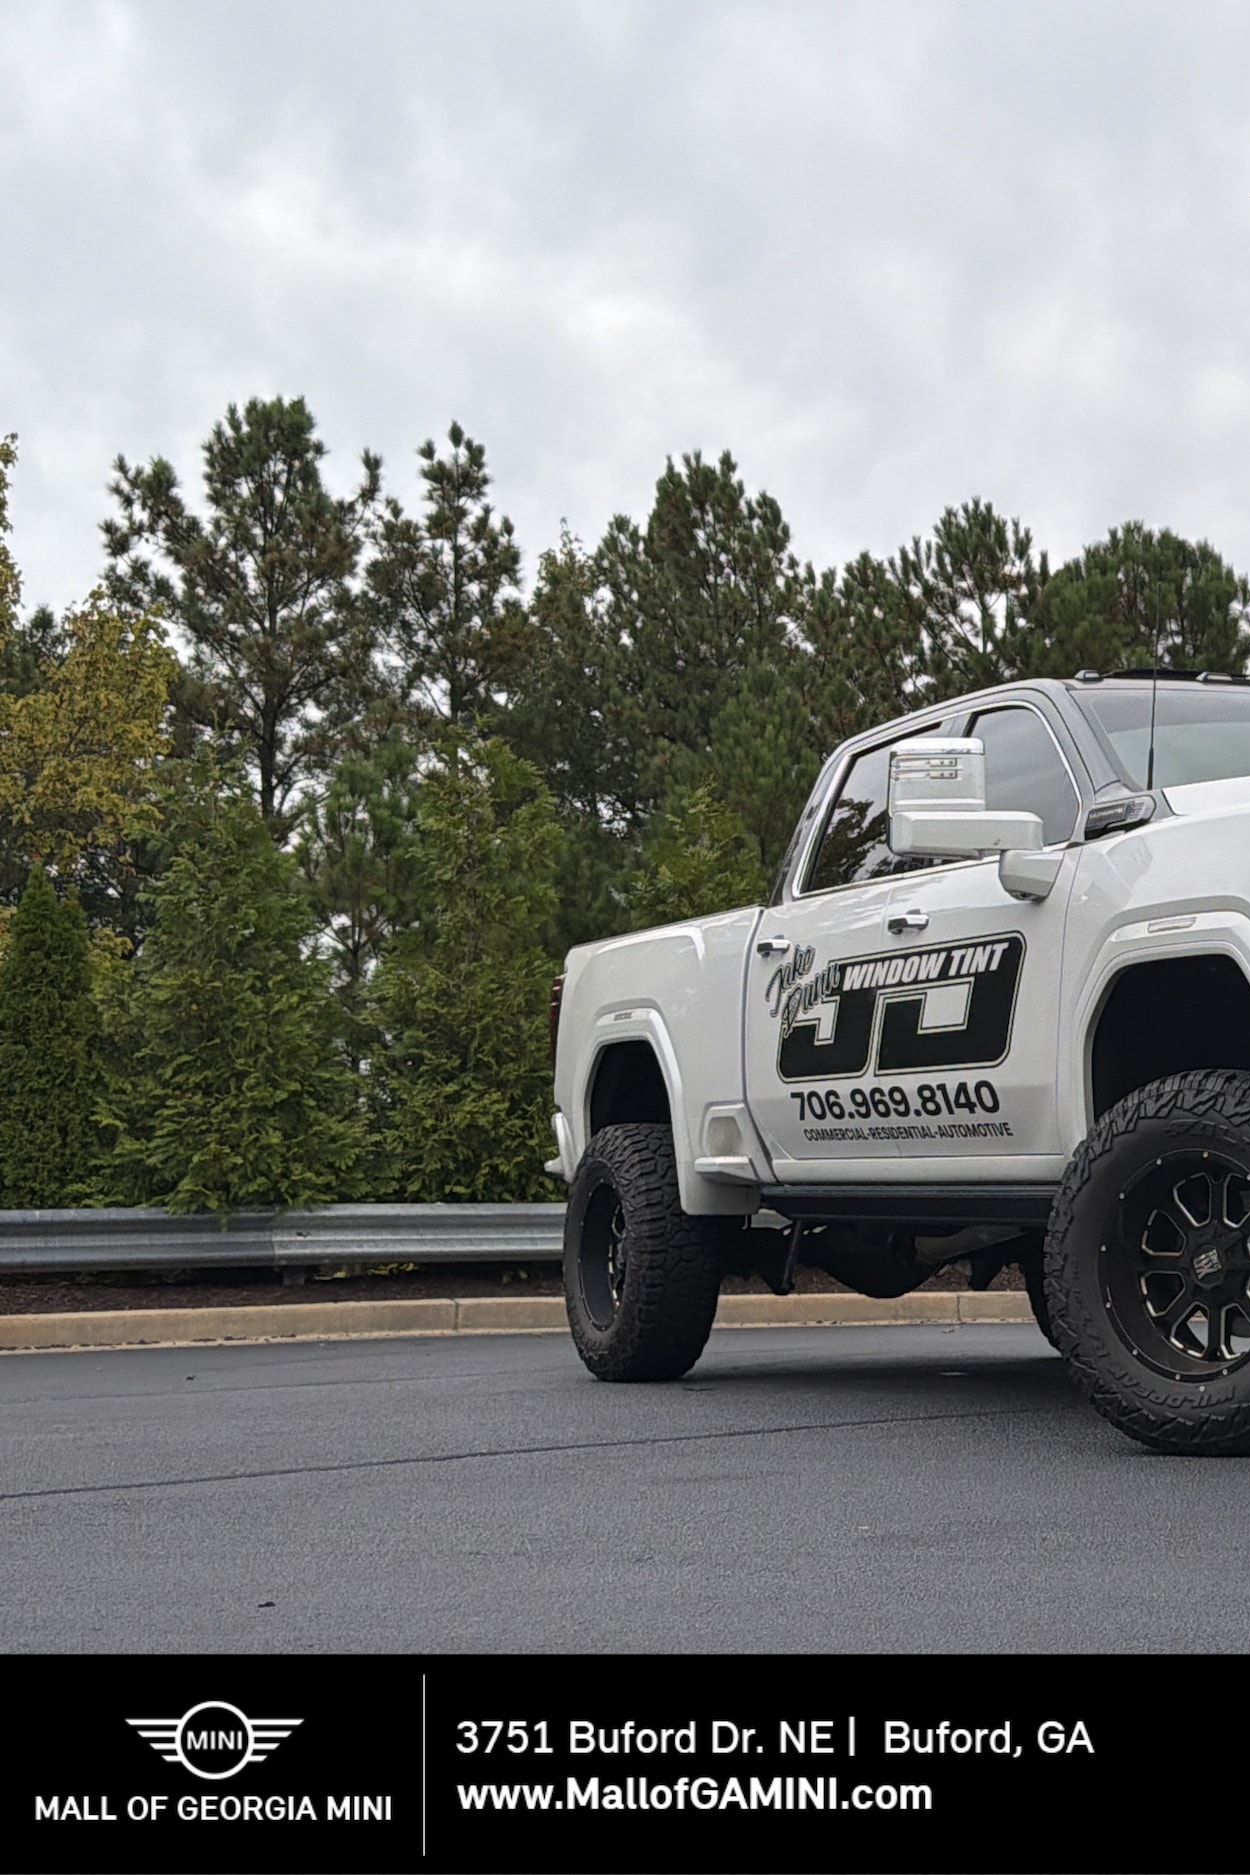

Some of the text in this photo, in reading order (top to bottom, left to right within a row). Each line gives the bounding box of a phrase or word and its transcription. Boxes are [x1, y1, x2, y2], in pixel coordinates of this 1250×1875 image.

[842, 942, 1010, 991] WINDOW TINT
[790, 1080, 1000, 1121] 706.969.8140
